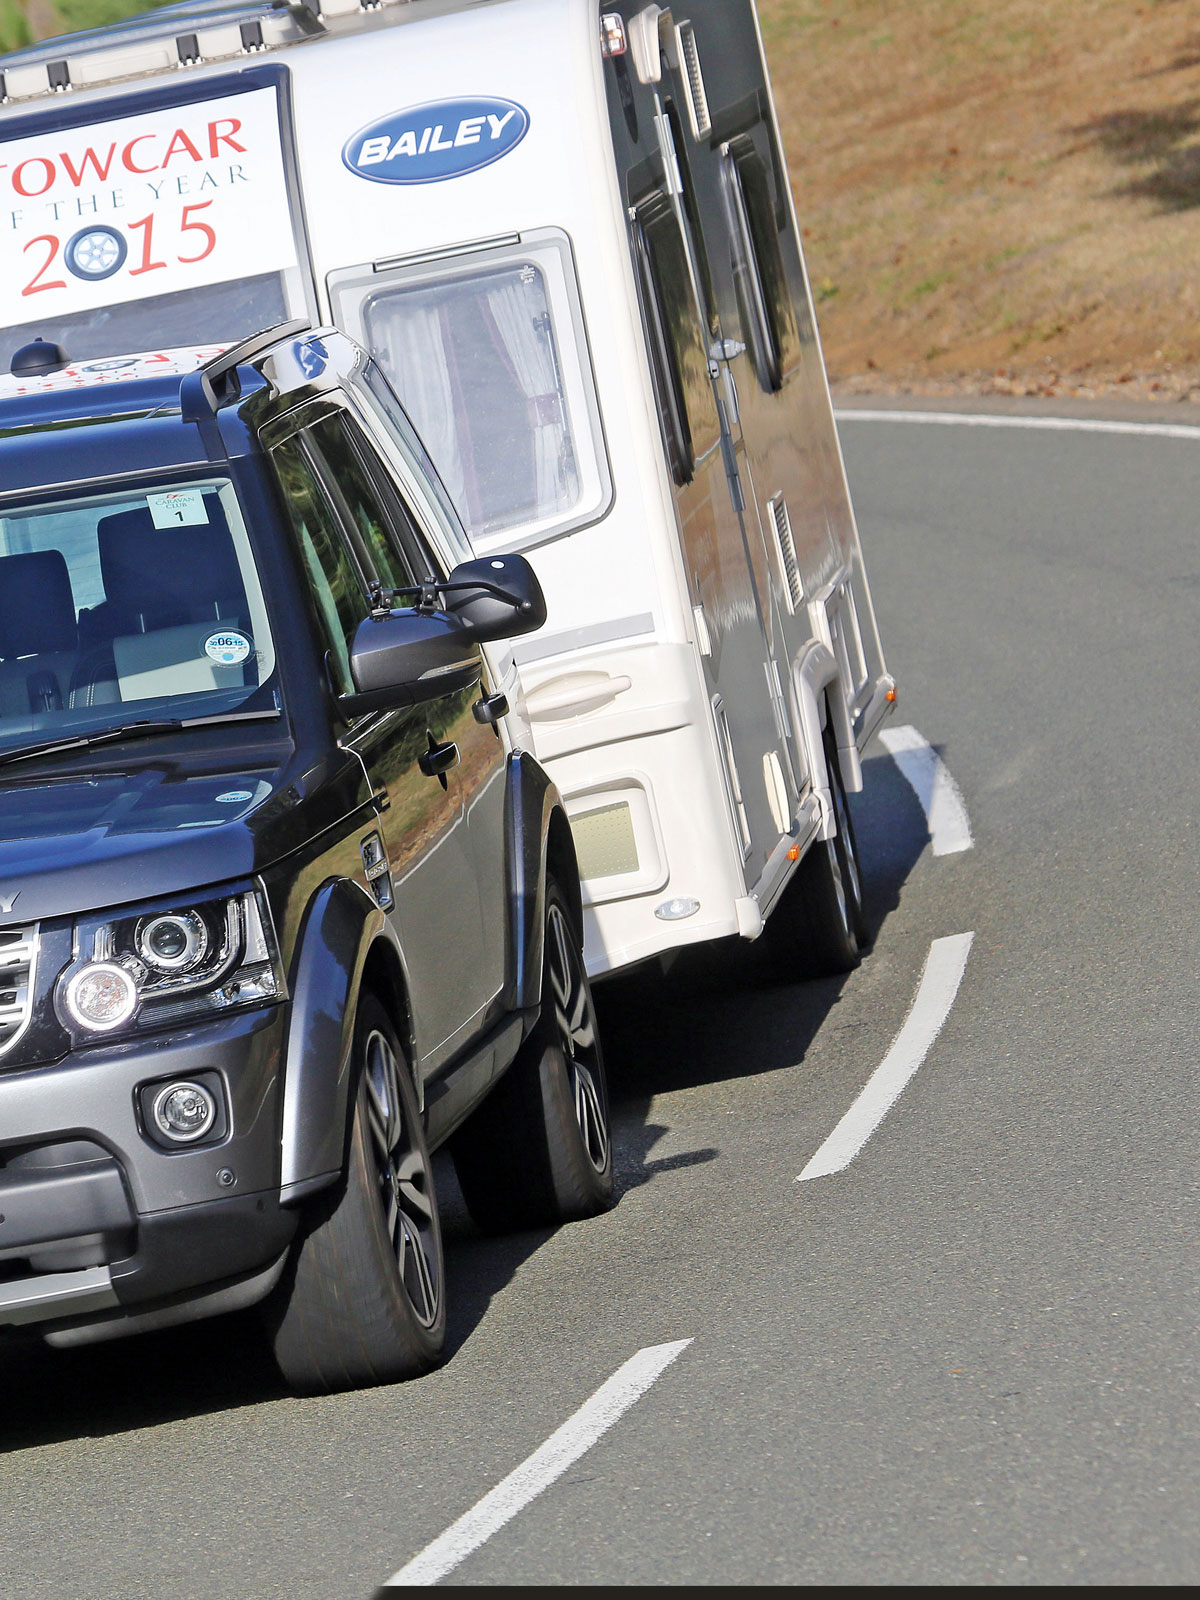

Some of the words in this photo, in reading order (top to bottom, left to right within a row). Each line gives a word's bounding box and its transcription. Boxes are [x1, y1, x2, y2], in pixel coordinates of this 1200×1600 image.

[356, 110, 516, 167] BAILEY
[46, 188, 125, 221] THE
[147, 164, 250, 200] YEAR
[174, 510, 184, 522] 1
[217, 637, 233, 646] 06
